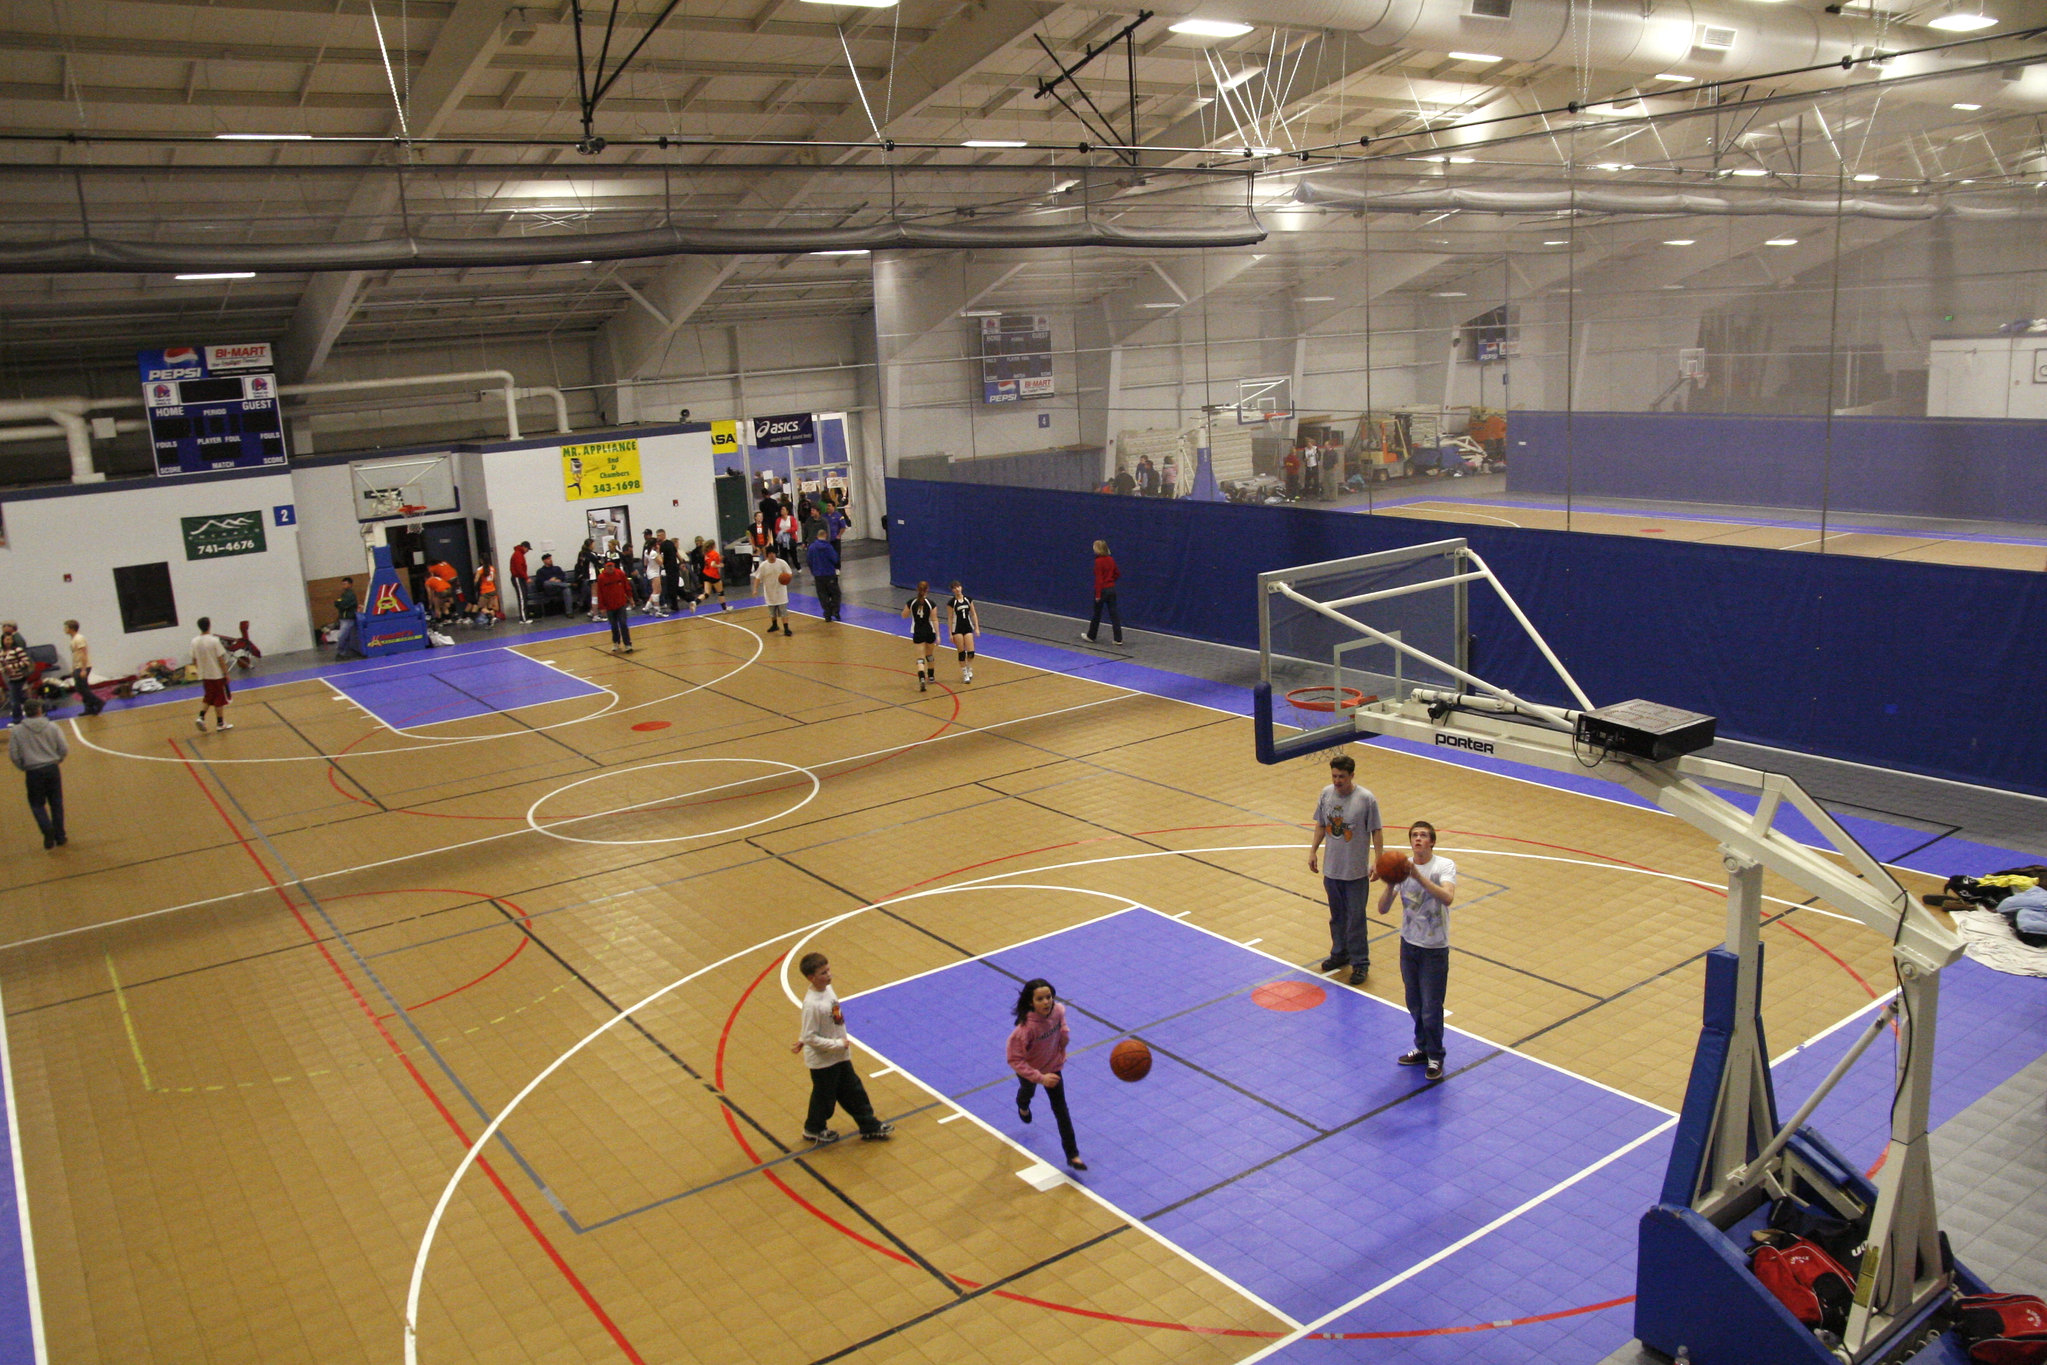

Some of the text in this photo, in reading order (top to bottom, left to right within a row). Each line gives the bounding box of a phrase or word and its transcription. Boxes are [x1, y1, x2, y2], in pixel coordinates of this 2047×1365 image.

[215, 346, 266, 358] BI-MART
[148, 367, 201, 380] PEPSI
[1024, 379, 1052, 389] BI-MART
[989, 393, 1018, 403] PEPSI
[242, 399, 272, 411] GUEST
[156, 406, 184, 417] HOME
[203, 408, 227, 416] PERIOD
[770, 420, 799, 435] asics
[197, 435, 242, 445] PLAYER FOUL
[260, 431, 280, 440] FOULS
[156, 440, 178, 449] FOULS
[562, 441, 637, 457] MR. APPLIANCE
[212, 460, 235, 469] MATCH
[263, 456, 284, 464] SCORE
[160, 465, 182, 474] SCORE
[600, 470, 630, 479] Chambers
[592, 480, 641, 494] 343-1698
[280, 509, 289, 522] 2
[197, 540, 255, 555] 741-4676
